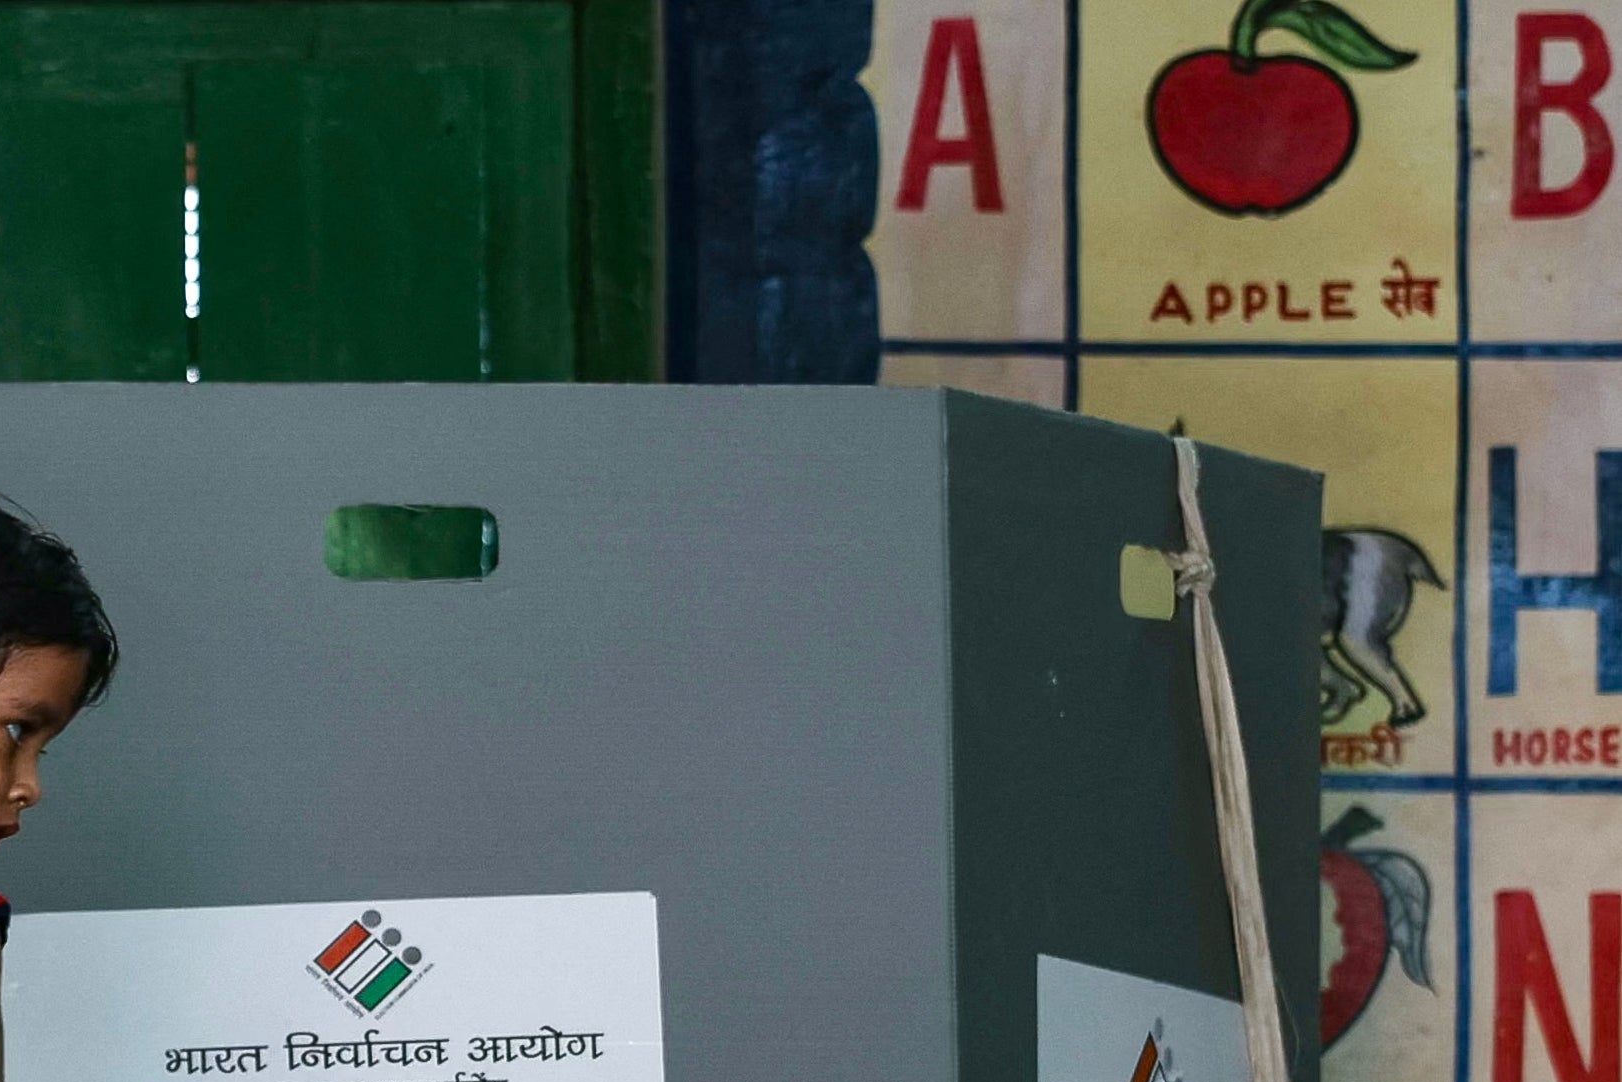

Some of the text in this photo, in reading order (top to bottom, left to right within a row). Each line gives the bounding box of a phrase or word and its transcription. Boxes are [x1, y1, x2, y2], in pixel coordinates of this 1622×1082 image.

[894, 18, 1005, 213] A
[1510, 13, 1616, 220] B
[1149, 257, 1440, 324] APPLE सेब
[1487, 446, 1622, 696] H
[1321, 722, 1403, 770] करी
[1492, 725, 1621, 768] HORSE
[164, 1025, 605, 1075] भारत निर्वाचन आयोग
